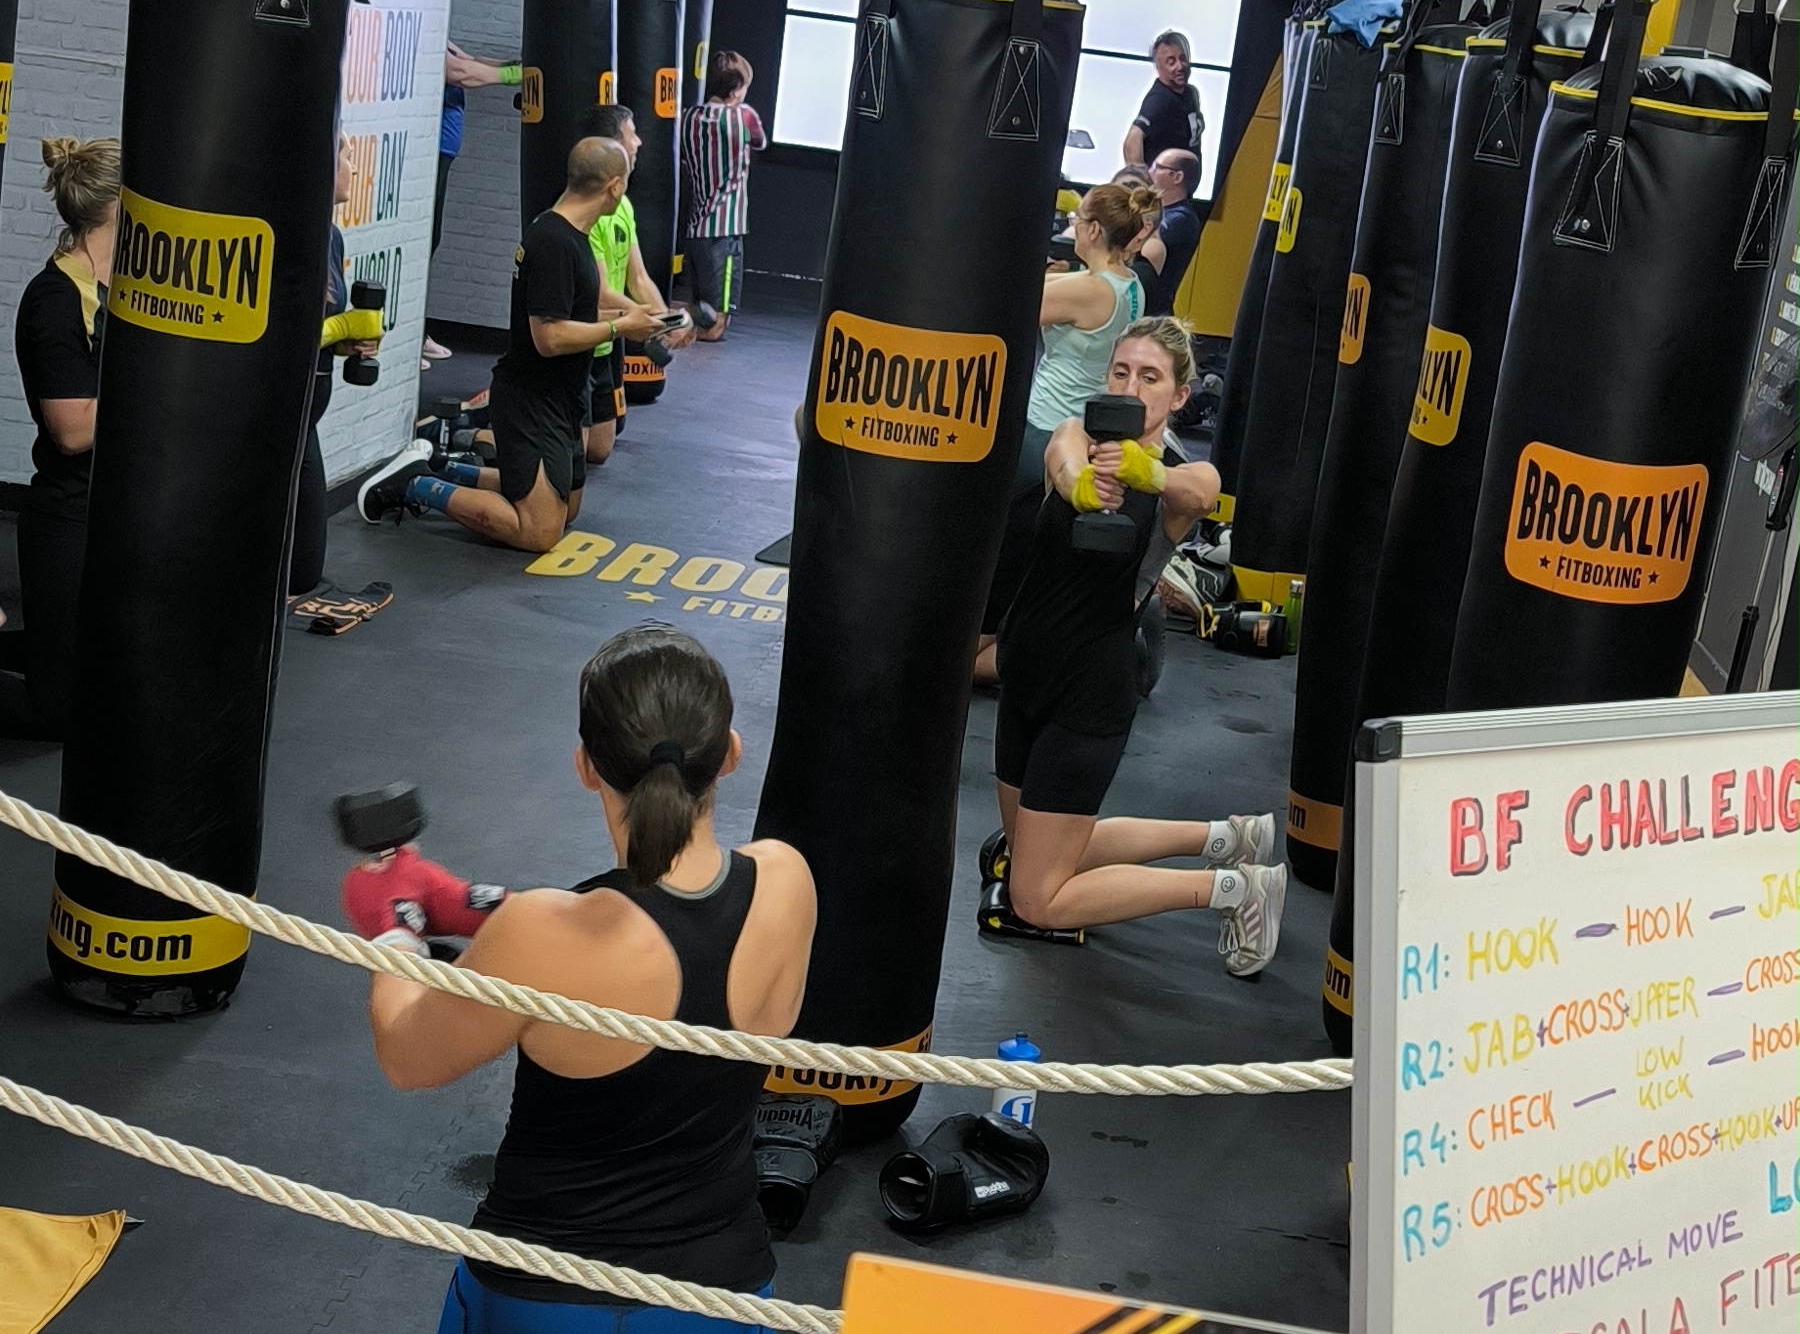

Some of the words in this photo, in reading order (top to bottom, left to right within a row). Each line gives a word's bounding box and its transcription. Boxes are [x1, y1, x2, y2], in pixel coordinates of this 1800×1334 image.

[380, 10, 424, 103] BODY
[334, 134, 377, 230] OUR
[377, 130, 408, 223] DAY
[130, 289, 205, 326] FITBOXING
[825, 325, 998, 429] BROOKLYN
[861, 416, 940, 447] FITBOXING
[1516, 457, 1701, 563] BROOKLYN
[524, 530, 789, 603] BROO
[1556, 555, 1643, 589] FITBOXING
[1449, 788, 1530, 876] BF
[1564, 758, 1800, 856] CHALLENG
[1401, 941, 1450, 1001] R1:
[1466, 916, 1560, 982] HOOK
[1625, 897, 1694, 947] HOOK
[1401, 1039, 1454, 1091] R2:
[1636, 1035, 1685, 1078] LOW
[1467, 1089, 1556, 1151] CHECK
[1637, 1073, 1694, 1111] KICK
[1402, 1121, 1458, 1177] R4:
[1402, 1200, 1463, 1263] R5:
[1477, 1240, 1653, 1328] TECHNICAL
[1667, 1209, 1744, 1260] MOVE
